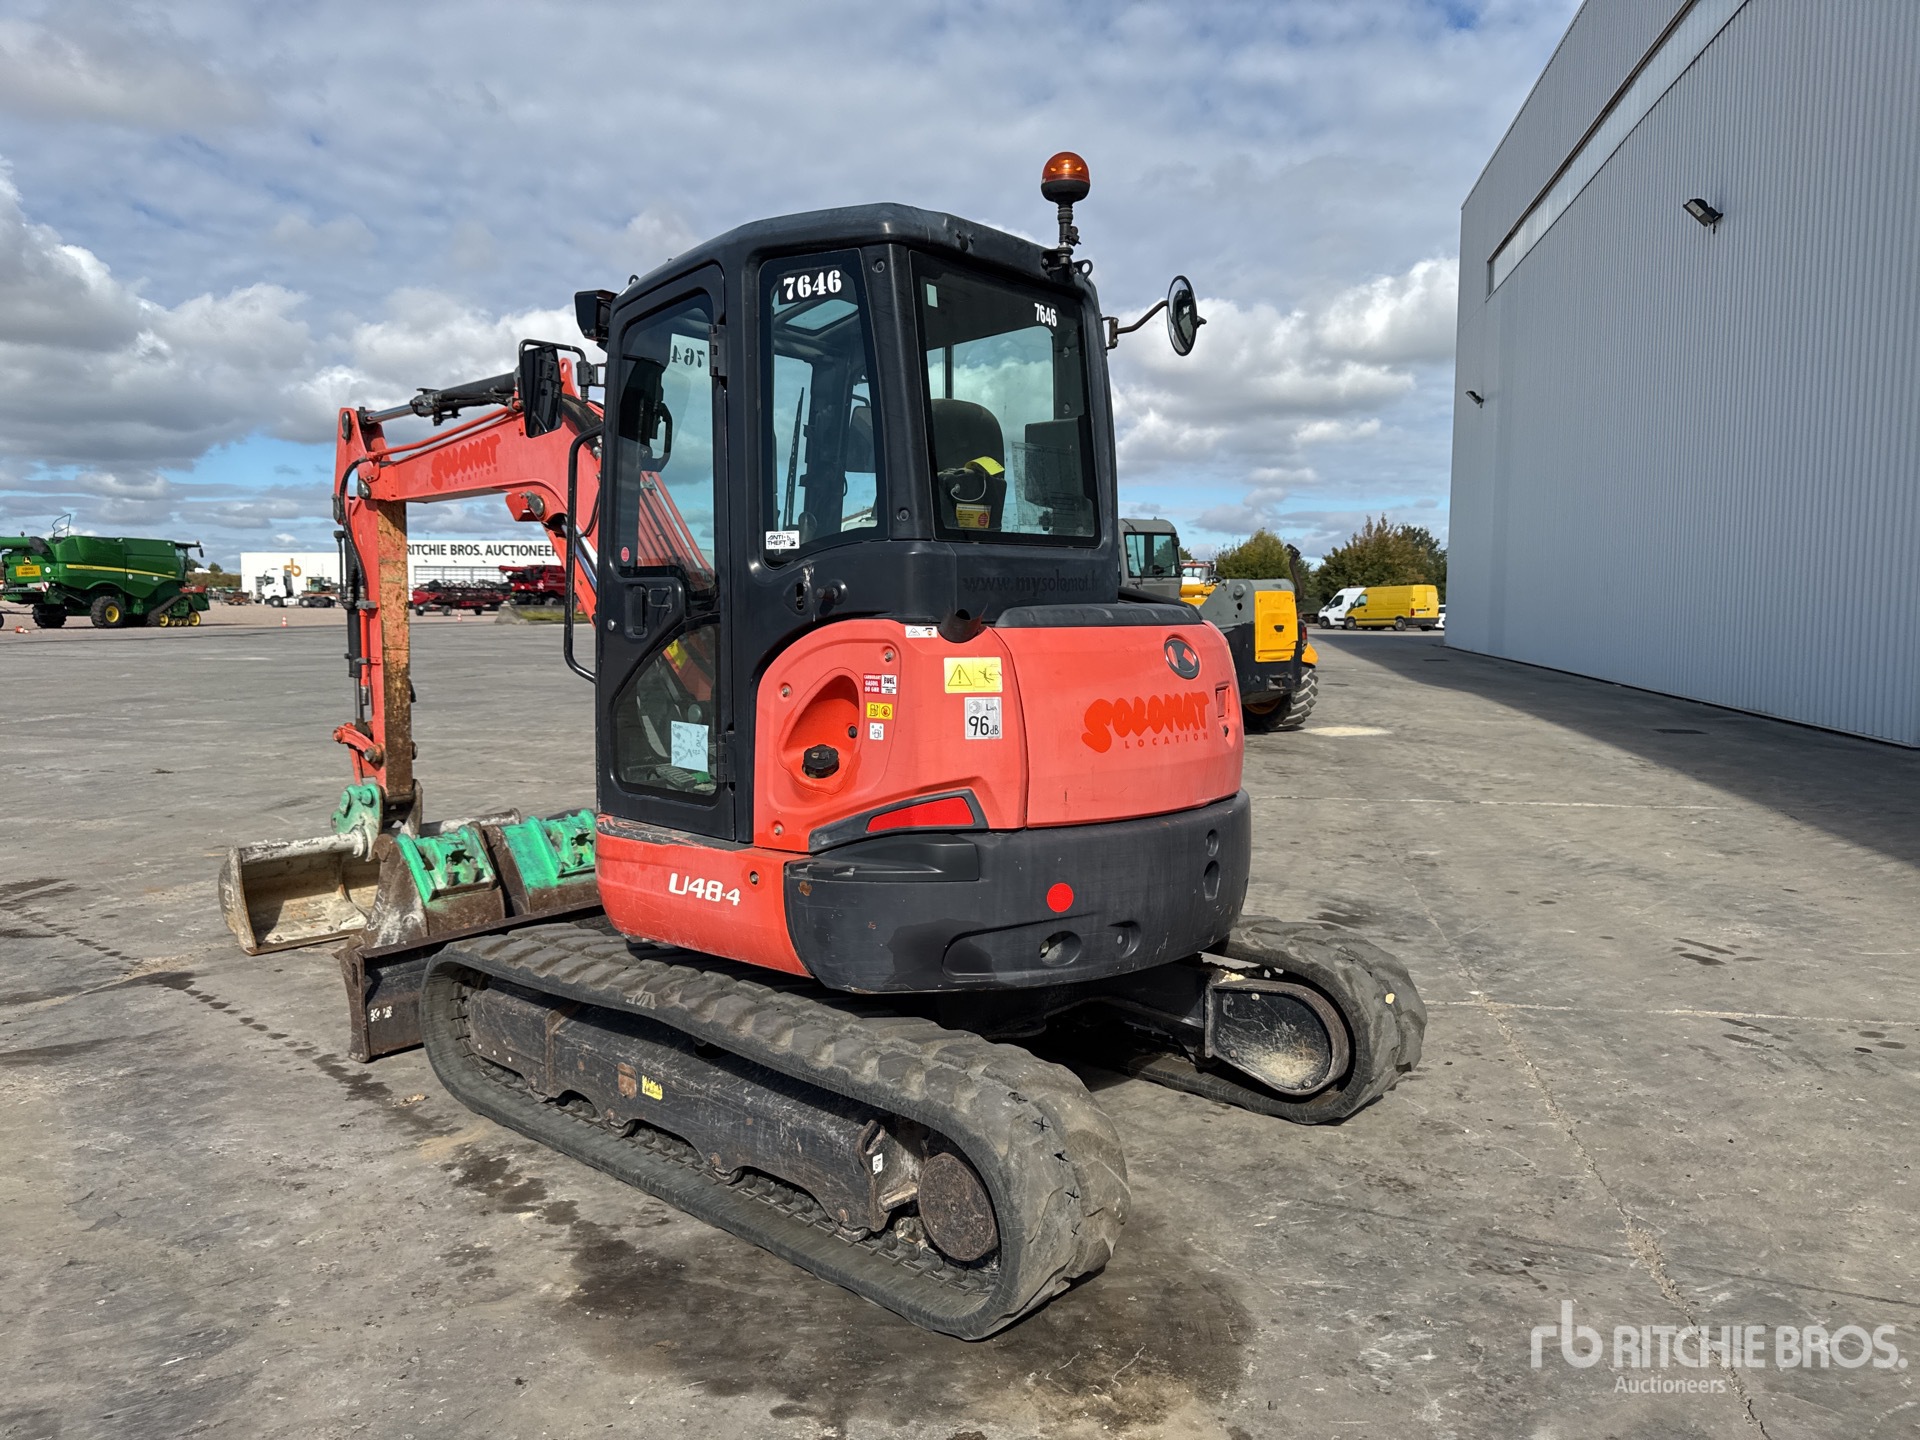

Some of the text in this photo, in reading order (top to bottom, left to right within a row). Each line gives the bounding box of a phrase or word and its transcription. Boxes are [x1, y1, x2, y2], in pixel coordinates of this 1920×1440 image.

[783, 269, 842, 301] 7646
[1034, 302, 1058, 327] 7646
[449, 544, 483, 556] BROS.
[968, 715, 999, 736] 96 dB
[1081, 690, 1210, 754] SOLOMAT
[1124, 732, 1210, 749] LOCATION
